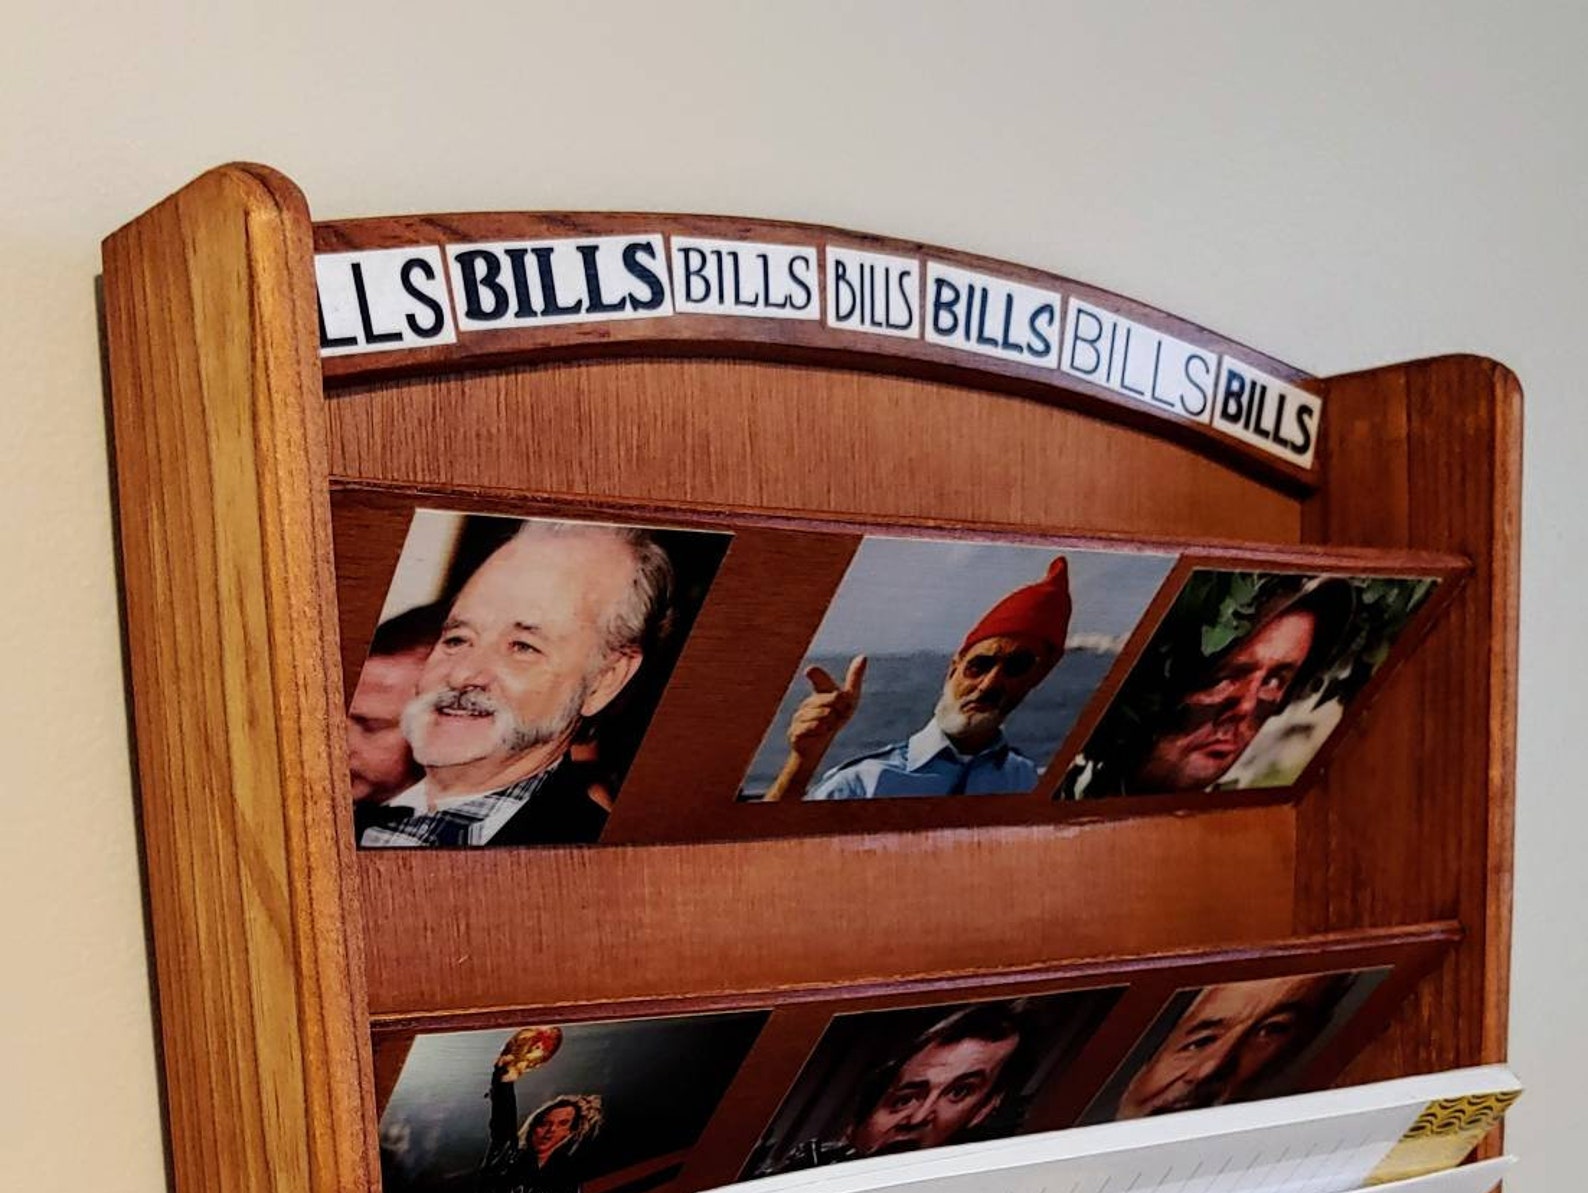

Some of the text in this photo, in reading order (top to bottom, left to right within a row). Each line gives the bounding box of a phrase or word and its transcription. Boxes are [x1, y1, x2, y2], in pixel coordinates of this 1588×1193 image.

[453, 241, 665, 322] BILLS
[677, 247, 812, 311] BILLS
[834, 258, 913, 331] BILLS
[932, 276, 1055, 358] BILLS
[1070, 307, 1211, 417] BILLS
[1219, 369, 1315, 457] BILLS
